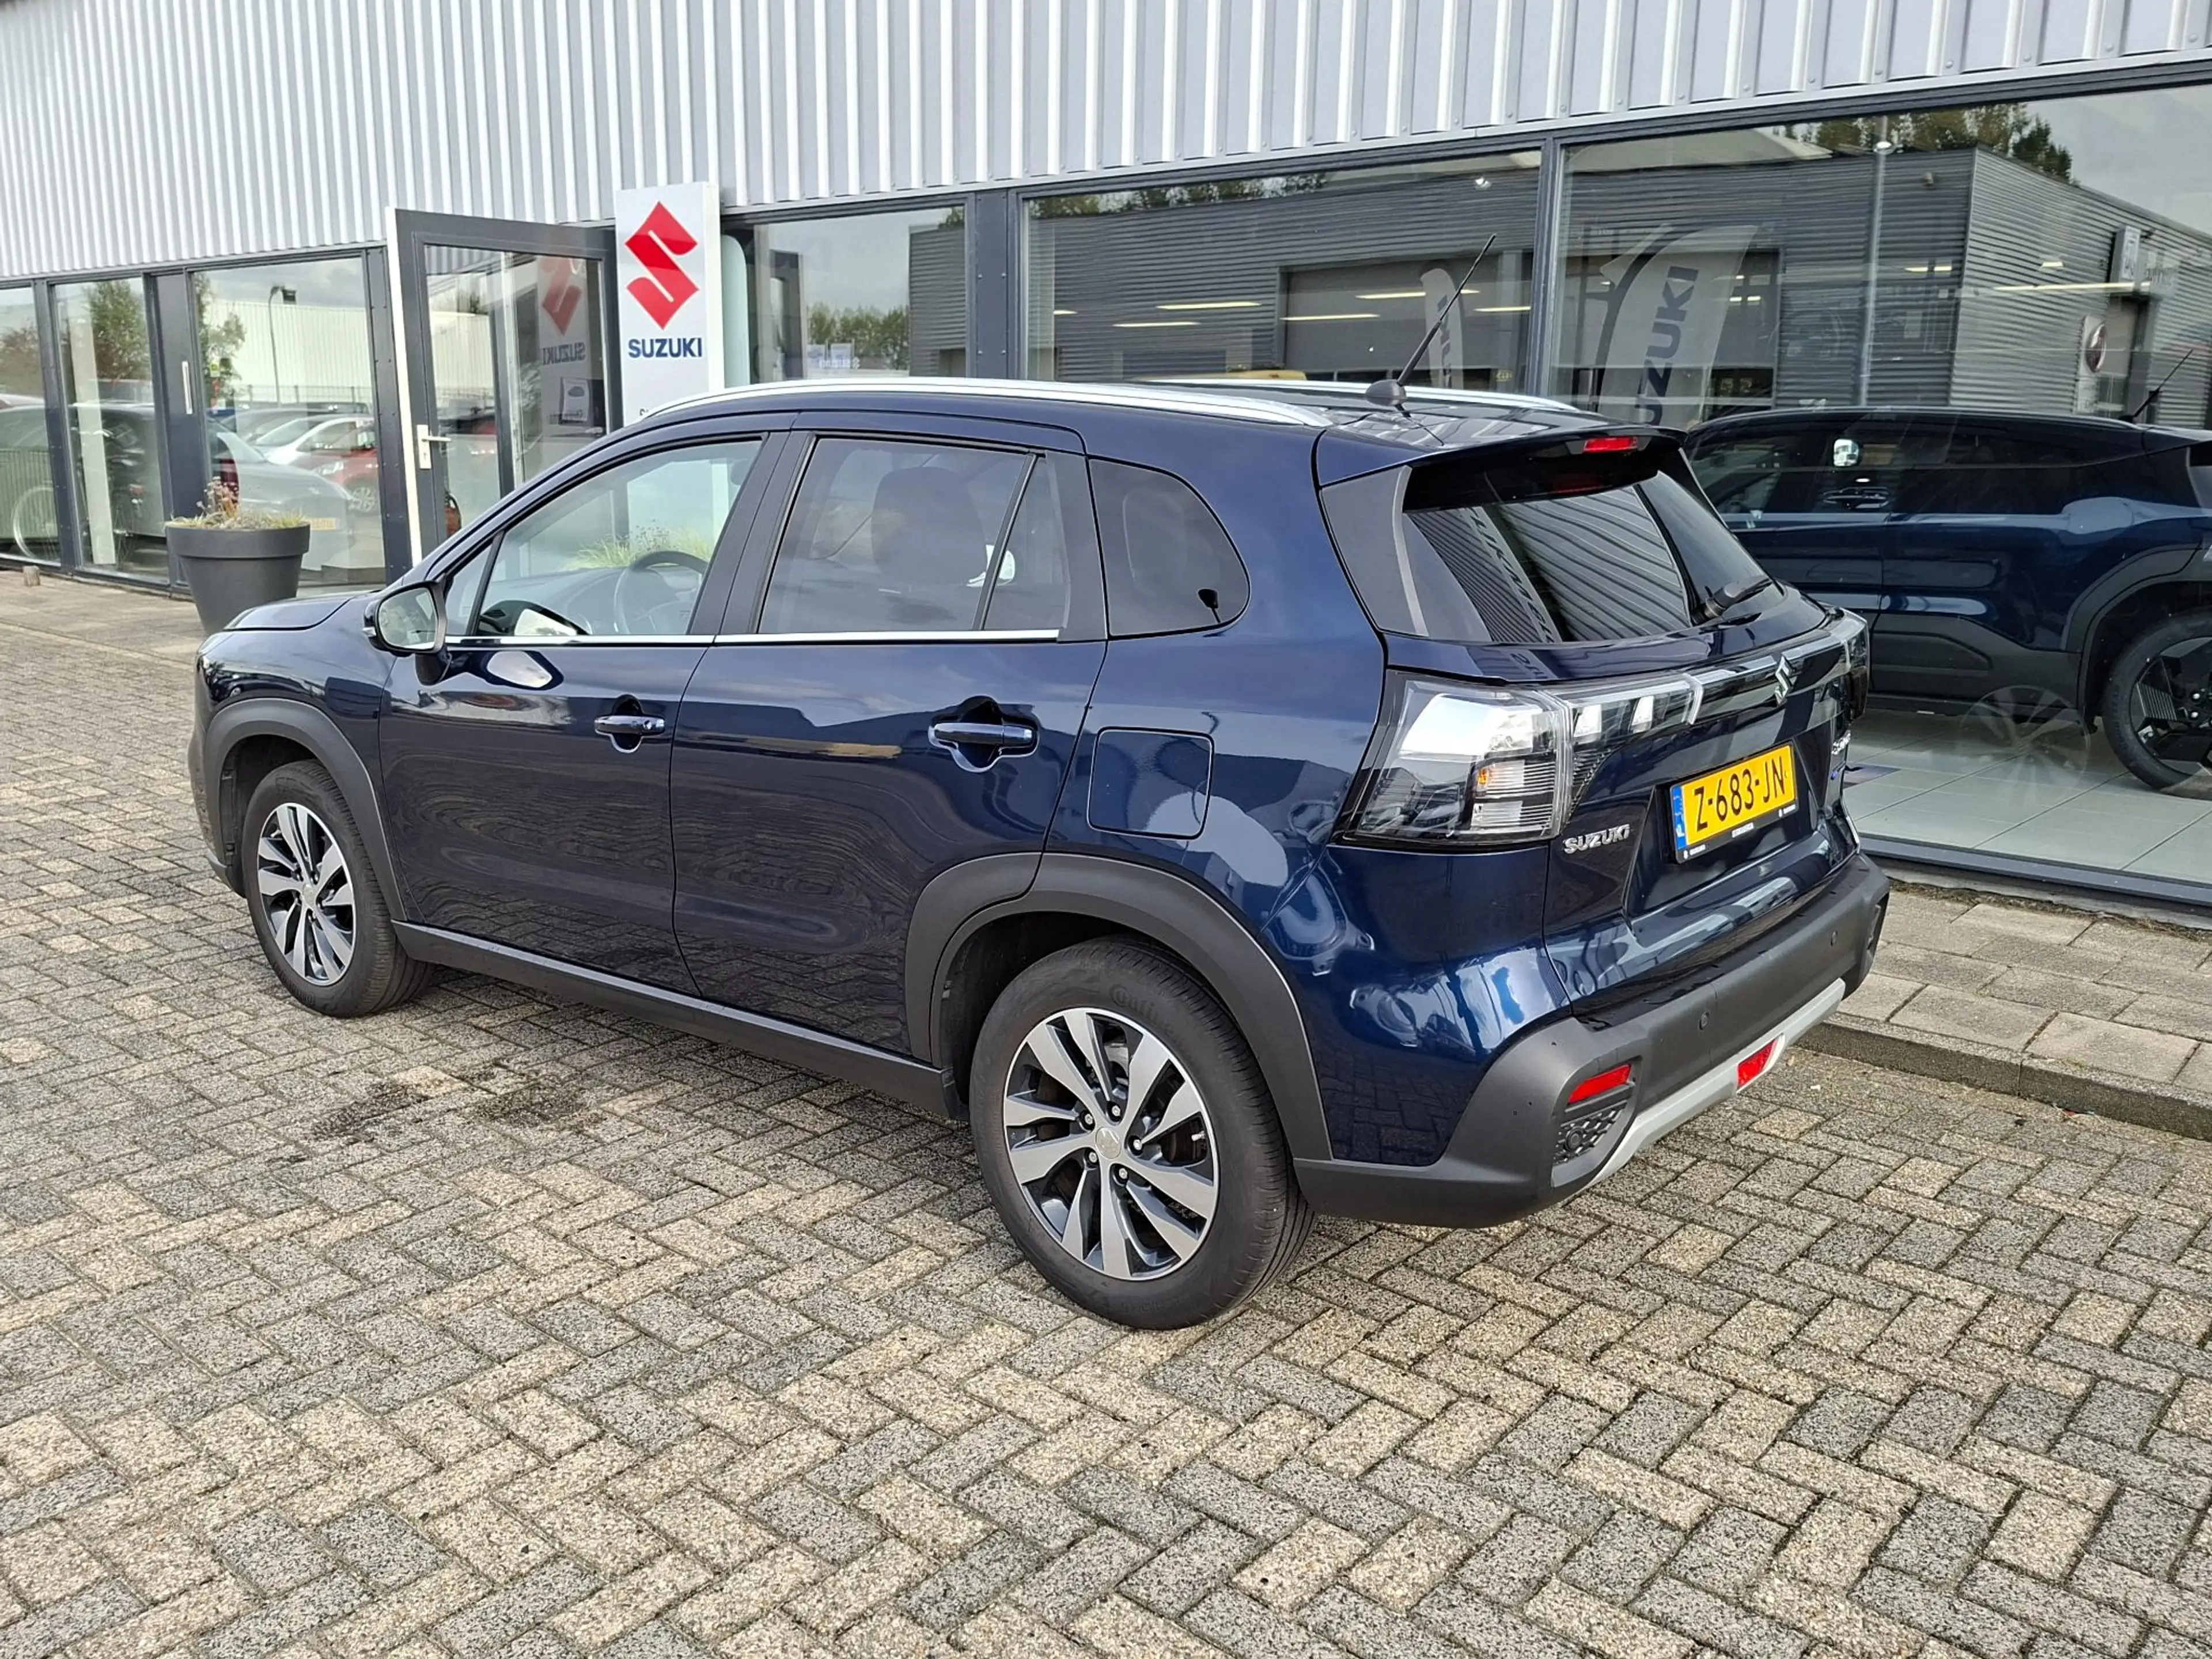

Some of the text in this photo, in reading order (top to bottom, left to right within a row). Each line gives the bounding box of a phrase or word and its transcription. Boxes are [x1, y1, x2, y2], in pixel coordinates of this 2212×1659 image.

[628, 338, 702, 358] SUZUKI
[1635, 266, 1699, 426] UZUKI
[1694, 756, 1785, 832] Z-683-JN
[1563, 824, 1630, 854] SUZUKI
